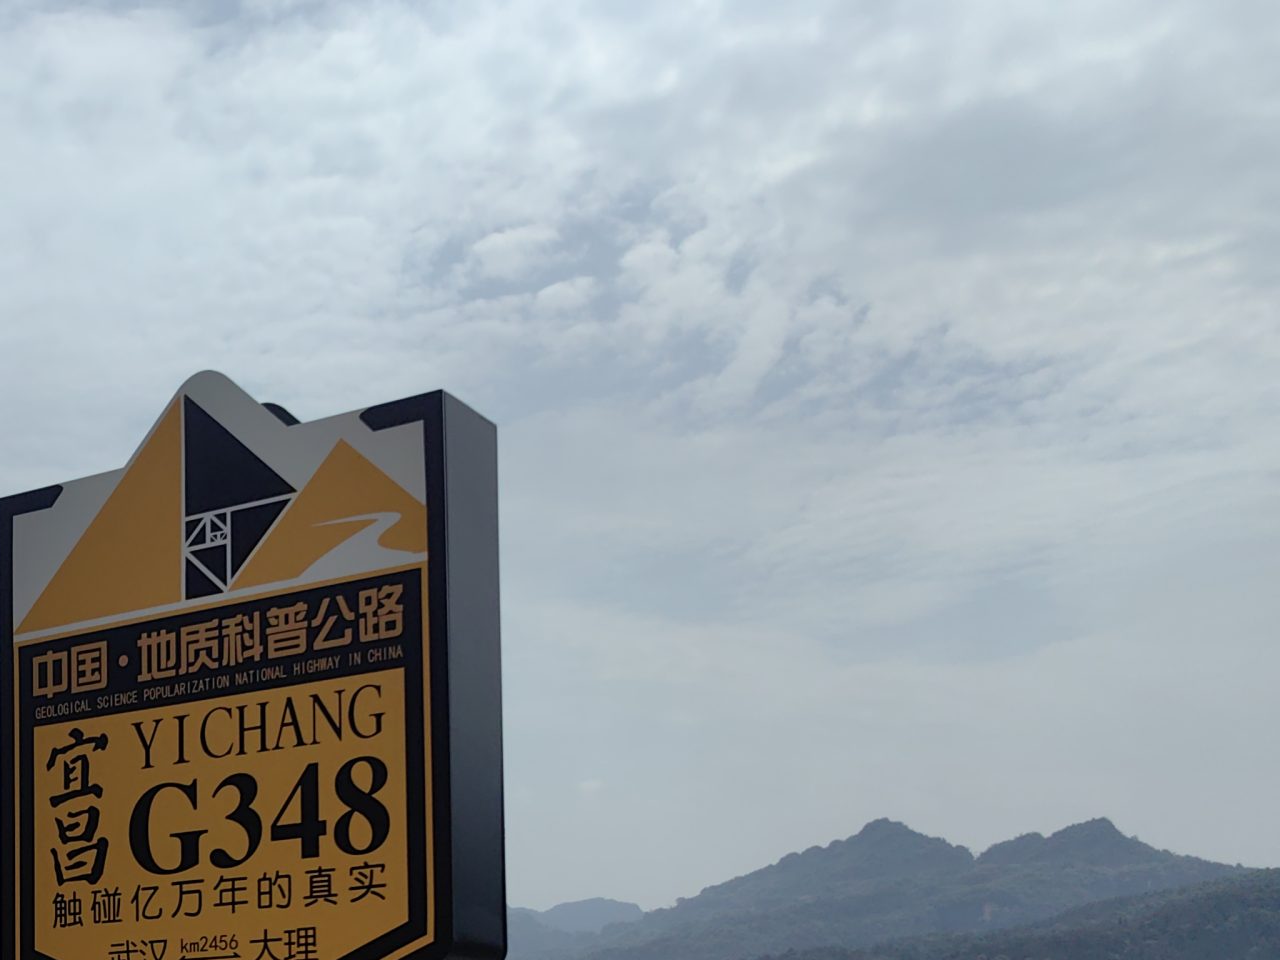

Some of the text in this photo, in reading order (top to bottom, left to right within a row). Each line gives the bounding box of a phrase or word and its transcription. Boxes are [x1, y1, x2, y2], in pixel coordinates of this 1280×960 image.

[35, 645, 404, 720] GEOLOGICAL SCIENCE POPULARIZATION NATIONAL HIGHWAY IN CHINA
[131, 684, 386, 770] YICHANG
[46, 727, 110, 888] 宜昌
[128, 755, 391, 876] G348
[53, 861, 387, 929] 触碰亿万年的真实
[180, 934, 239, 954] km2456
